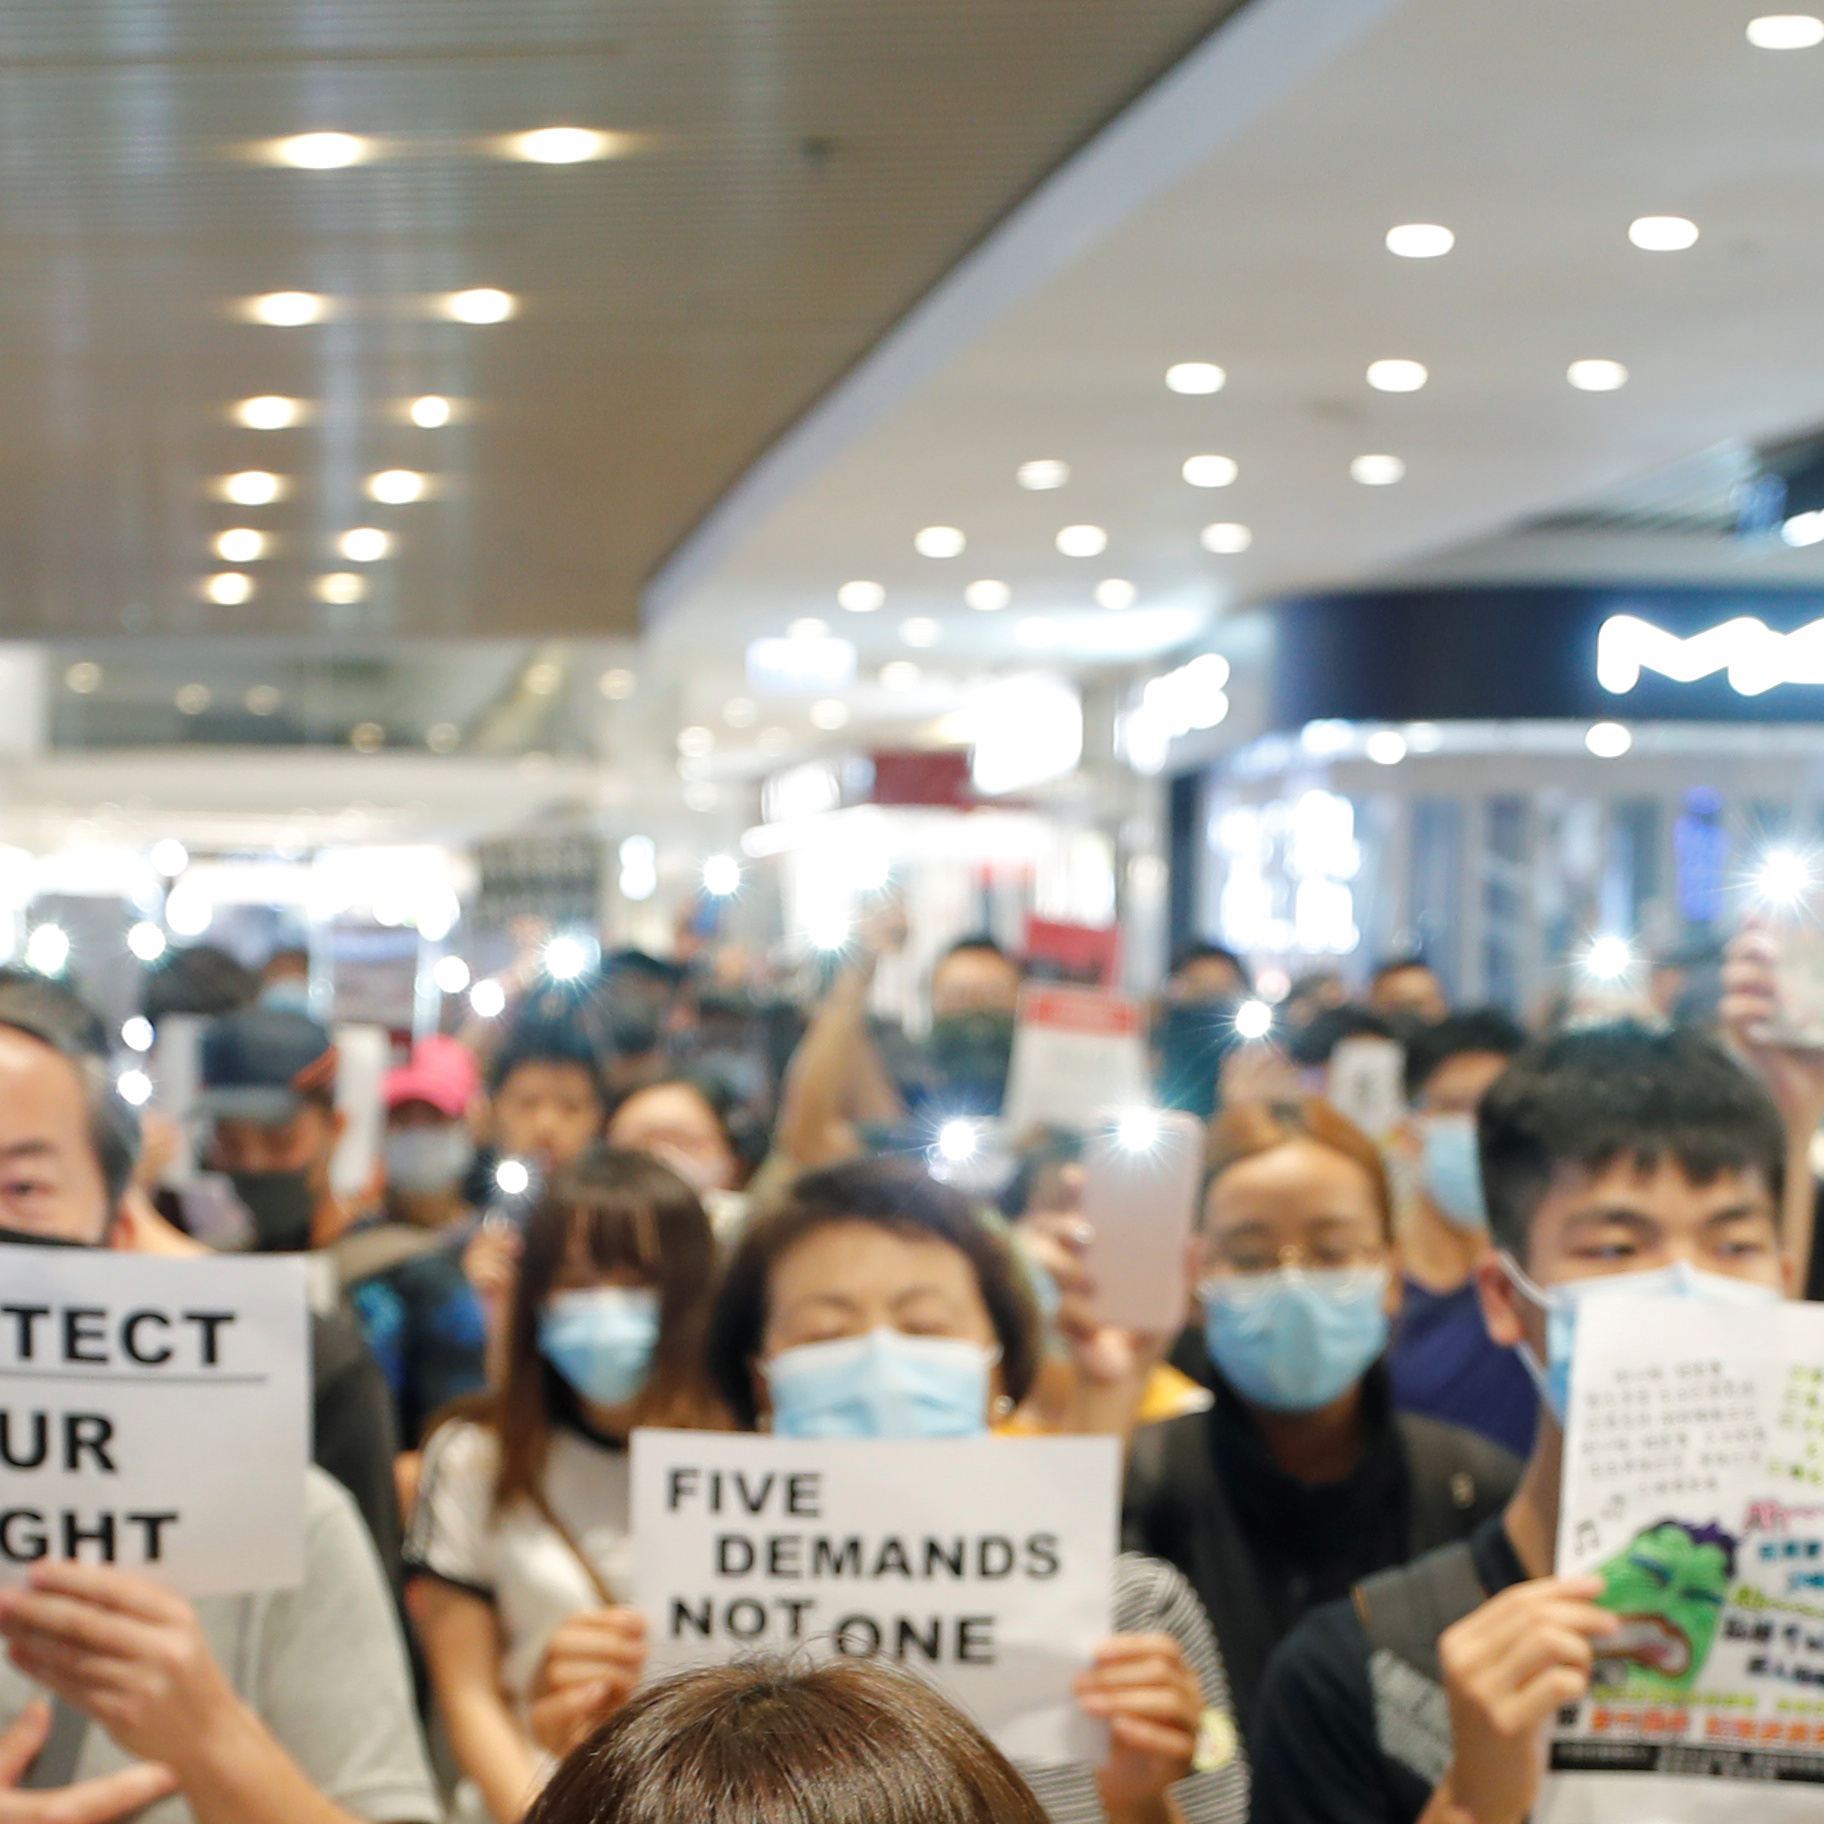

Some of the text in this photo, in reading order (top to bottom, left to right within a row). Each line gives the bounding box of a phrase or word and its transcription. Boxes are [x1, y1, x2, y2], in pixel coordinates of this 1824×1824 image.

[667, 1468, 822, 1518] FIVE
[716, 1532, 1061, 1581] DEMANDS
[670, 1597, 998, 1664] NOT ONE
